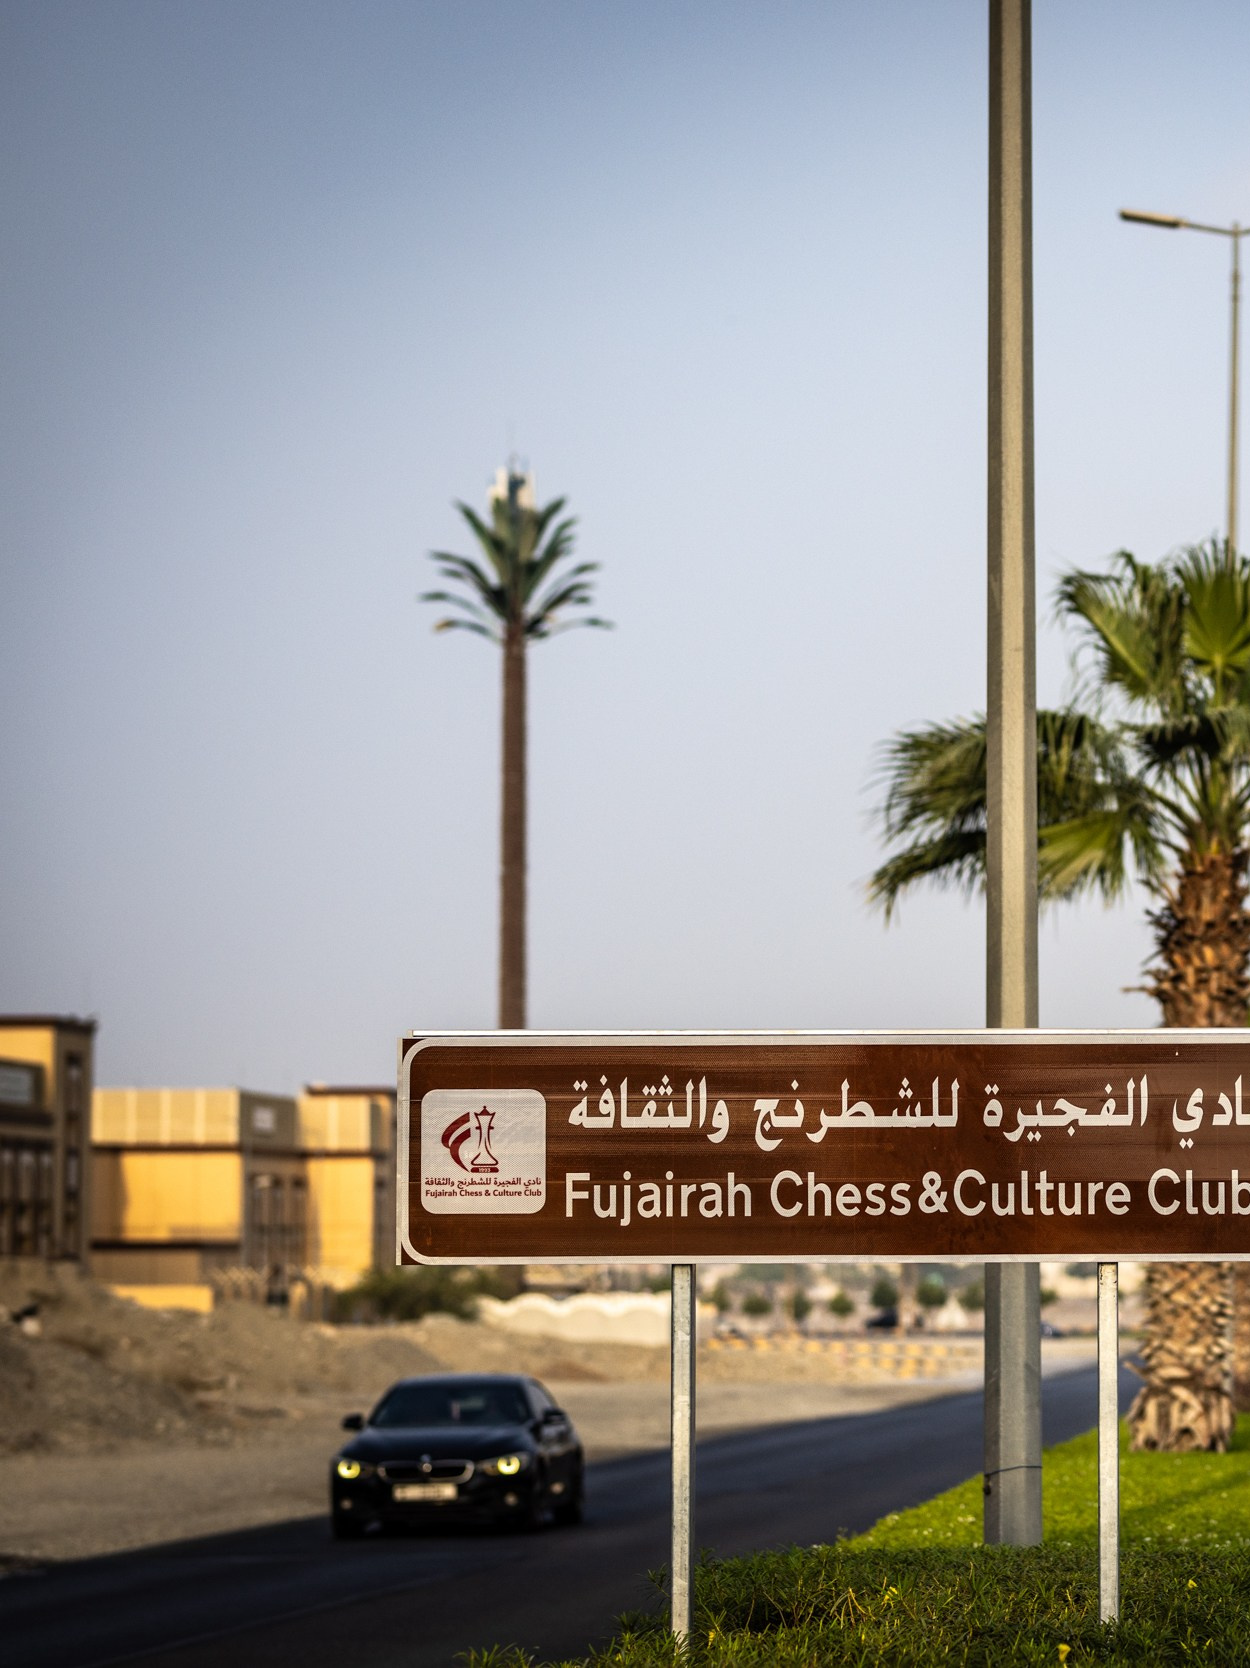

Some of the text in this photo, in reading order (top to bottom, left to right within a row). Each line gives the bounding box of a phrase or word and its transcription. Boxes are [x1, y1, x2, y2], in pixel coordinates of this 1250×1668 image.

[568, 1074, 730, 1144] والثقافة
[753, 1076, 960, 1152] للشطرنج
[983, 1073, 1149, 1142] الفجيرة
[424, 1177, 542, 1190] نادي الفجيرة للشطرنج والثقافة
[425, 1188, 542, 1198] Fujairah Chess & Culture Club
[565, 1170, 752, 1227] Fujairah
